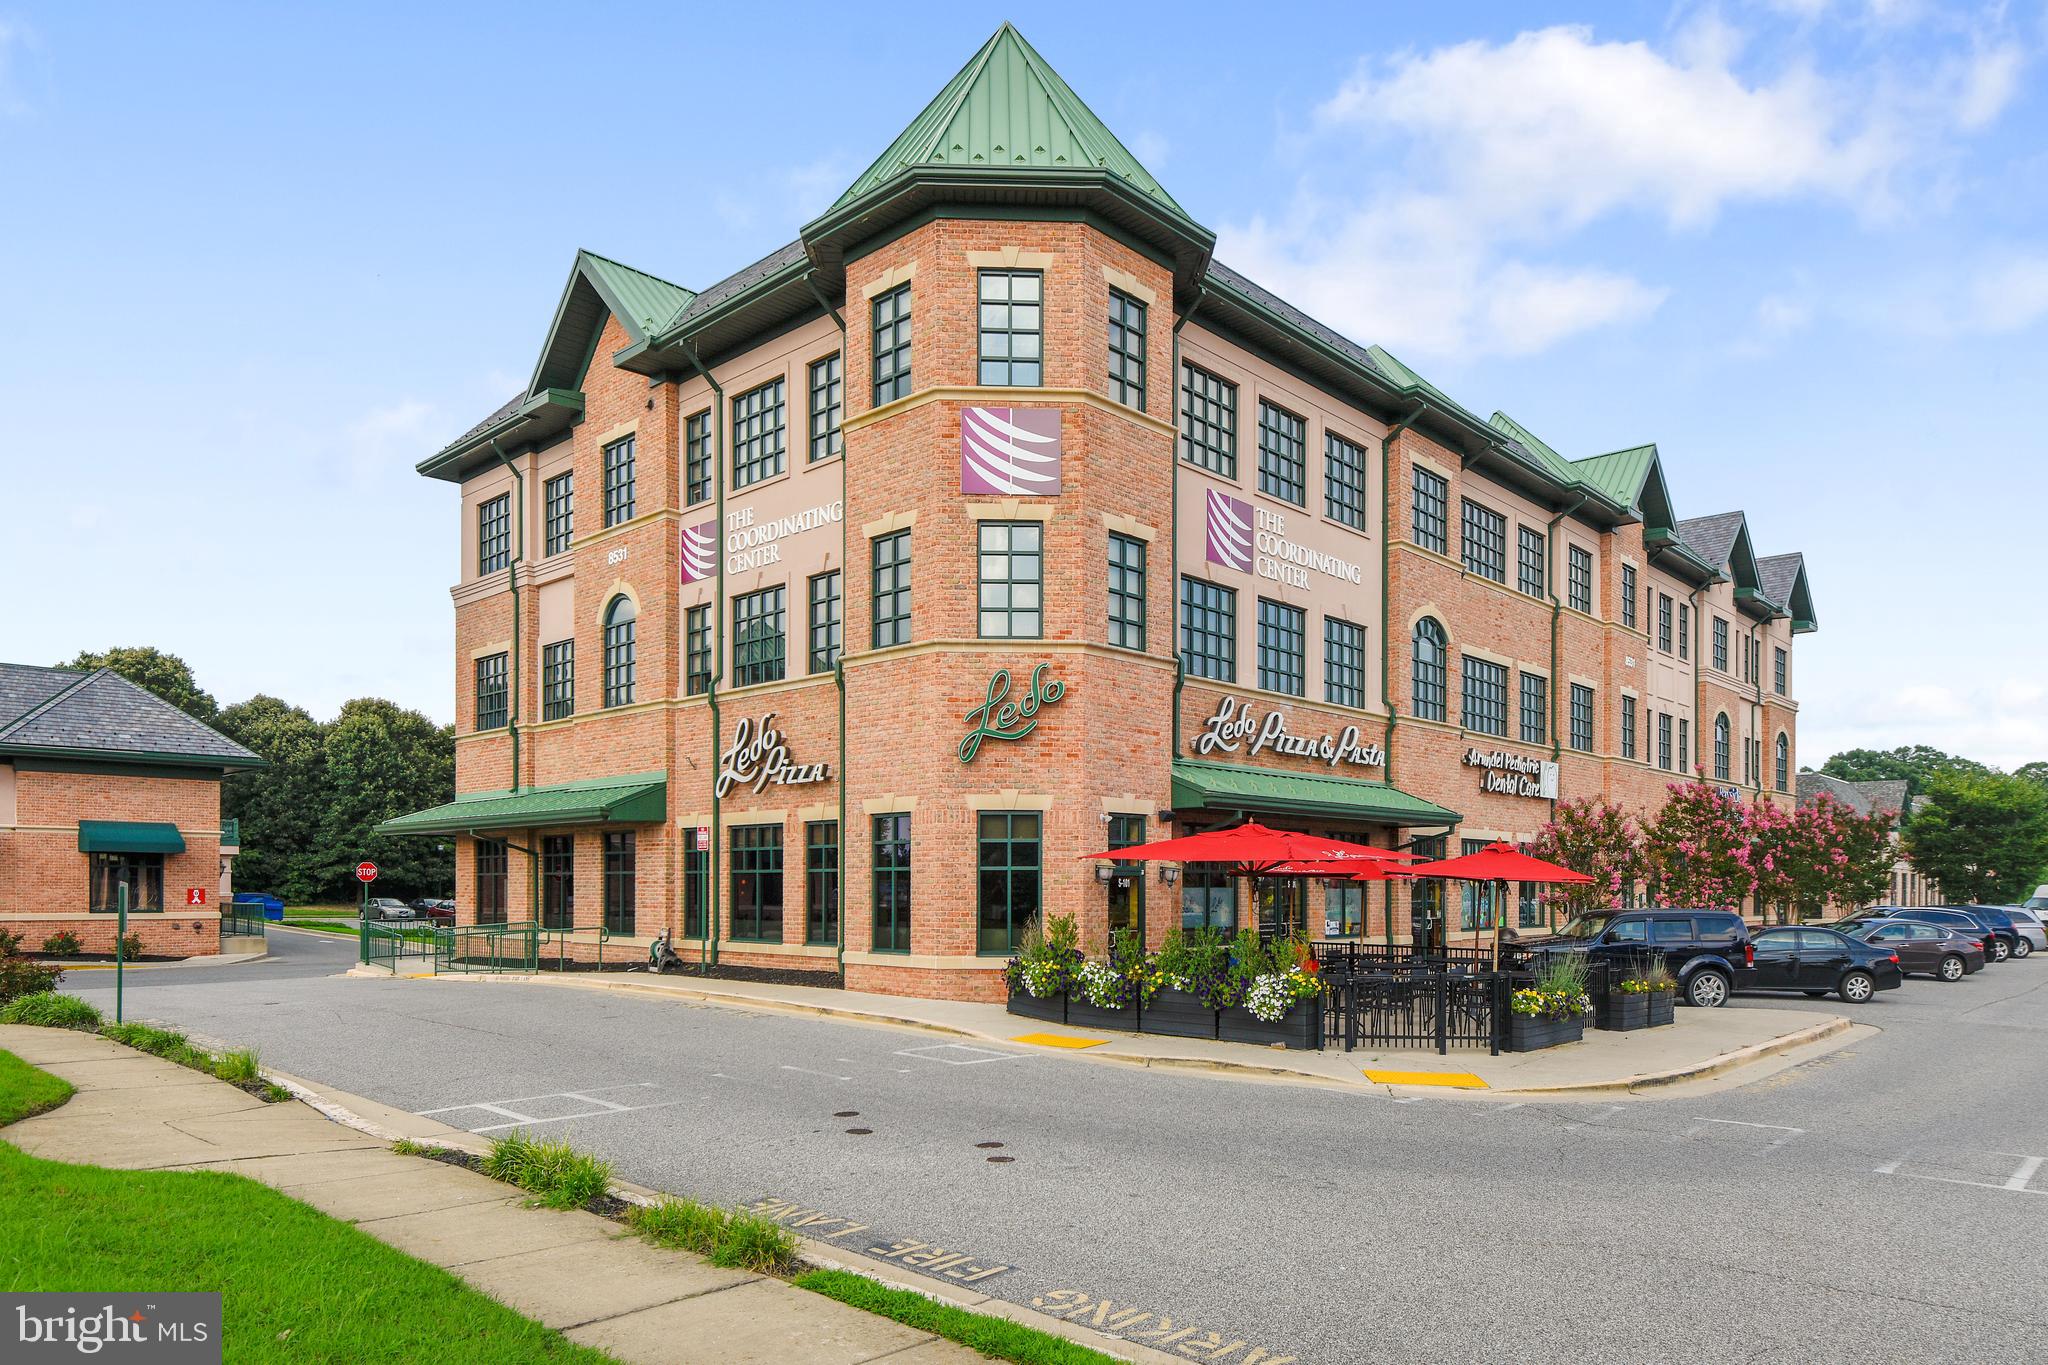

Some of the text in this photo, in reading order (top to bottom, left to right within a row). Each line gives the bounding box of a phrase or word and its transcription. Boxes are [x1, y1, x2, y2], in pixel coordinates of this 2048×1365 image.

[727, 507, 754, 532] THE
[727, 501, 843, 553] COORDINATING
[1256, 507, 1285, 536] THE
[608, 546, 627, 565] 8531
[727, 544, 781, 575] CENTER
[1256, 532, 1361, 585] COORDINATING
[1256, 557, 1311, 591] CENTER
[959, 662, 1065, 763] Ledo
[1198, 695, 1257, 755] Ledo
[1320, 735, 1334, 759] &
[716, 712, 779, 798] Ledo
[1467, 747, 1540, 775] Arundel Pediatric
[1486, 770, 1540, 797] Dental Care
[357, 867, 376, 876] STOP
[867, 1239, 1009, 1282] FIRE
[1031, 1288, 1298, 1365] ARKING
